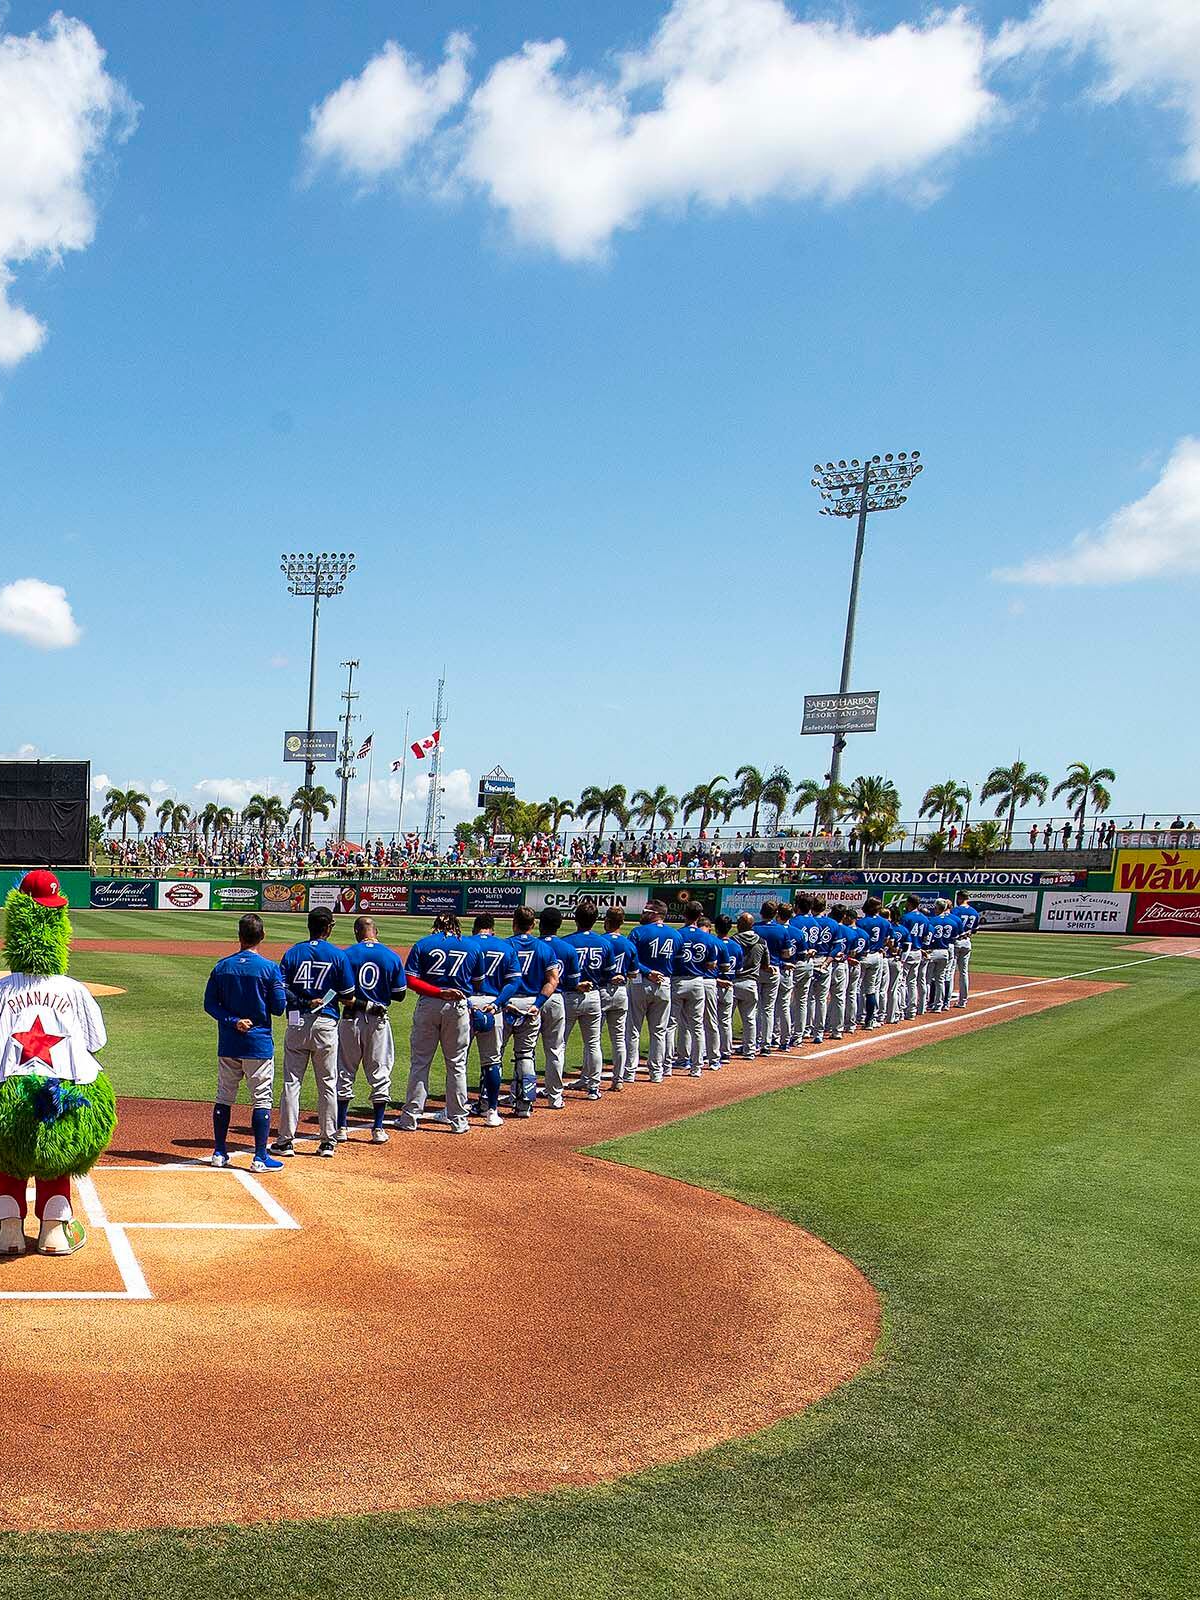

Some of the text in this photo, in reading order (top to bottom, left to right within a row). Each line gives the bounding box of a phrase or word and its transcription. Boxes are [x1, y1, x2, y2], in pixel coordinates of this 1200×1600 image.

[806, 697, 877, 708] SAFETY HARBOR
[806, 711, 837, 719] RESORT
[1121, 833, 1188, 845] BELCHER
[863, 872, 922, 884] WORLD
[927, 872, 1033, 885] CHAMPIONS
[50, 883, 58, 894] P
[467, 886, 522, 895] CANDLEWOOD
[827, 891, 839, 900] the
[840, 891, 867, 901] Beach"
[968, 892, 1028, 900] cademybus.com
[960, 914, 976, 928] 73
[1048, 910, 1118, 922] CUTWATER
[871, 926, 881, 941] 3
[910, 922, 925, 937] 41
[934, 924, 952, 939] 33
[649, 937, 674, 959] 14
[682, 942, 707, 962] 53
[426, 948, 468, 977] 27
[575, 947, 603, 970] 75
[293, 960, 333, 990] 47
[359, 962, 380, 990] 0
[7, 991, 73, 1015] PHANATIC
